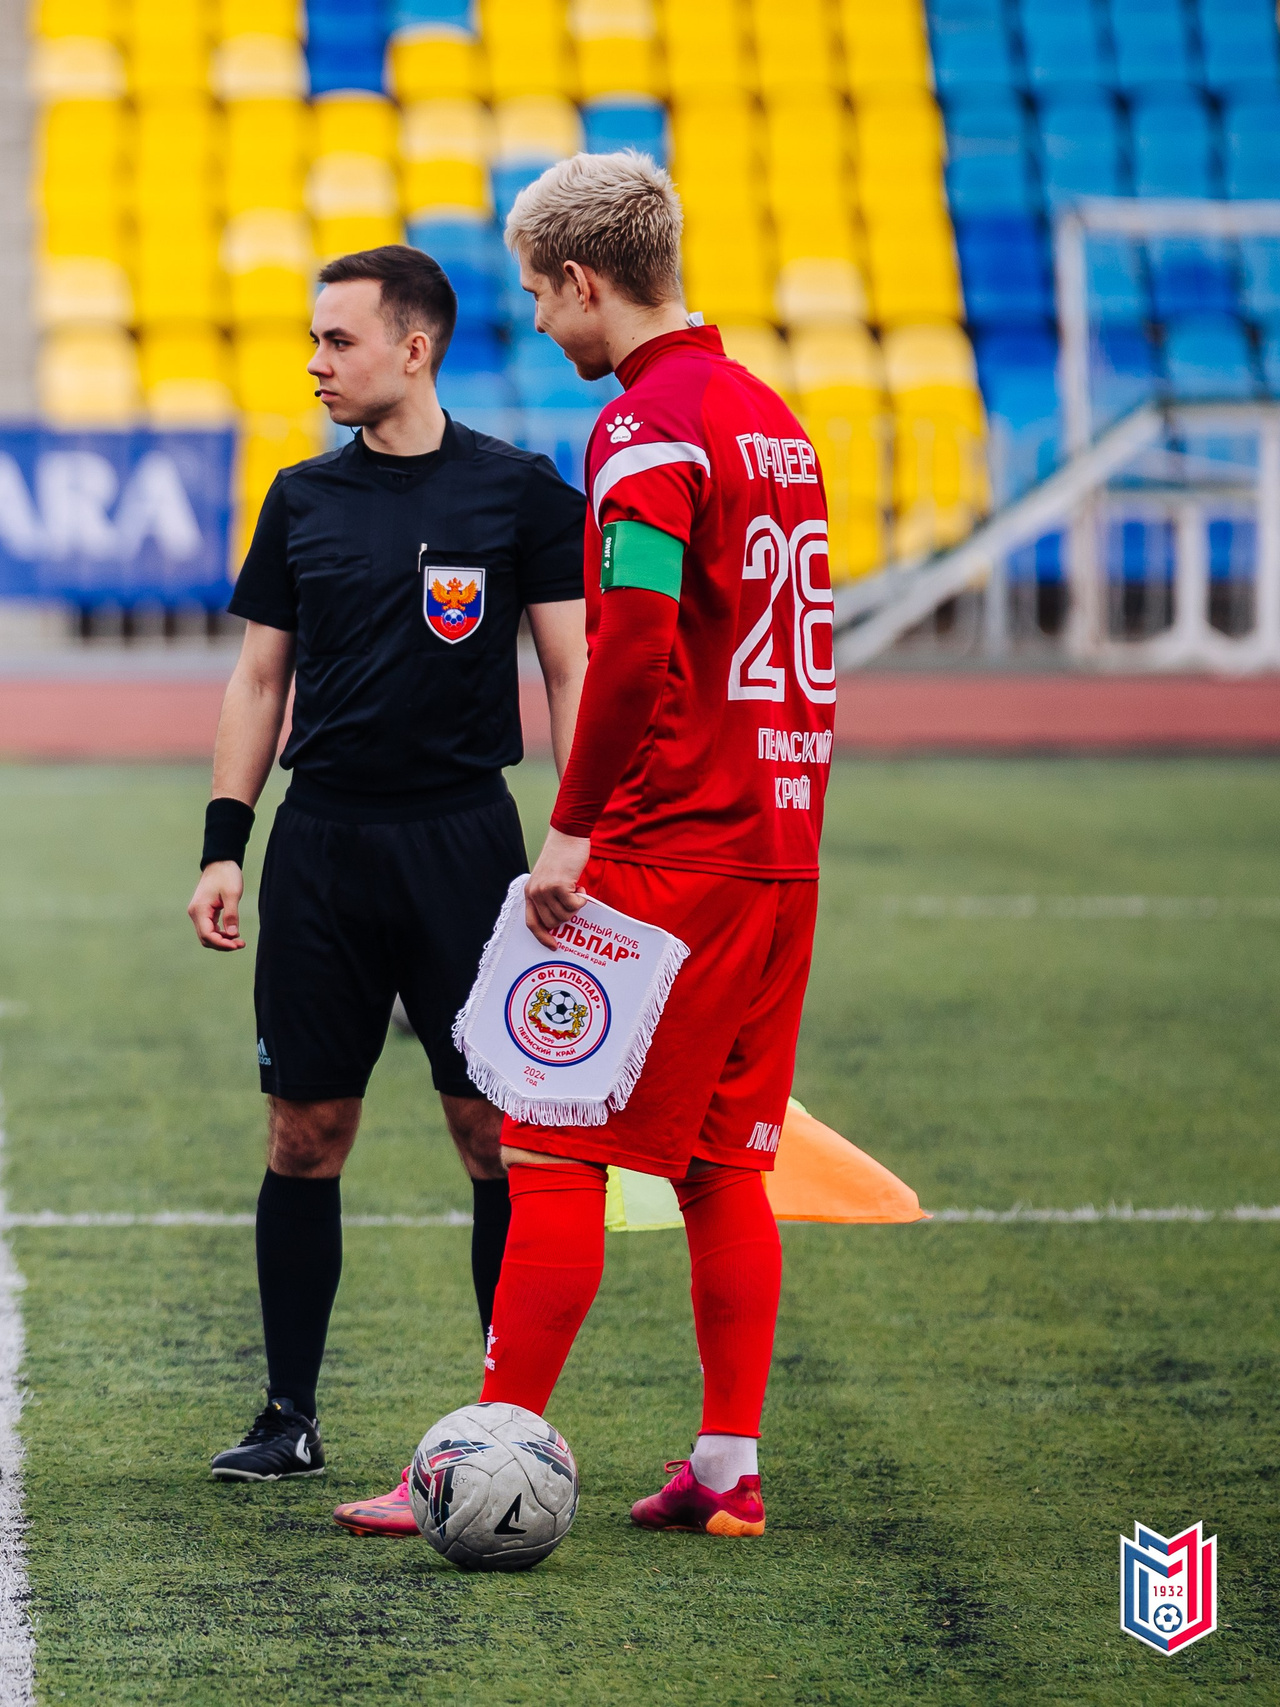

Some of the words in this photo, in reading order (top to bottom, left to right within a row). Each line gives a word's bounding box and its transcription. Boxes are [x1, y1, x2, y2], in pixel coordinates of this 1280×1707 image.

[604, 536, 612, 558] JAKO
[774, 774, 811, 810] КРАЙ
[570, 915, 613, 938] ОЛЬНЫЙ
[613, 933, 640, 949] КЛУБ
[590, 956, 607, 967] край
[537, 969, 555, 980] ФК
[559, 969, 600, 1002] ИЛЬПАР
[518, 1026, 551, 1055] ПЕРМСКИЙ
[556, 1047, 576, 1057] КРАЙ
[523, 1065, 546, 1081] 2024
[525, 1077, 538, 1087] год
